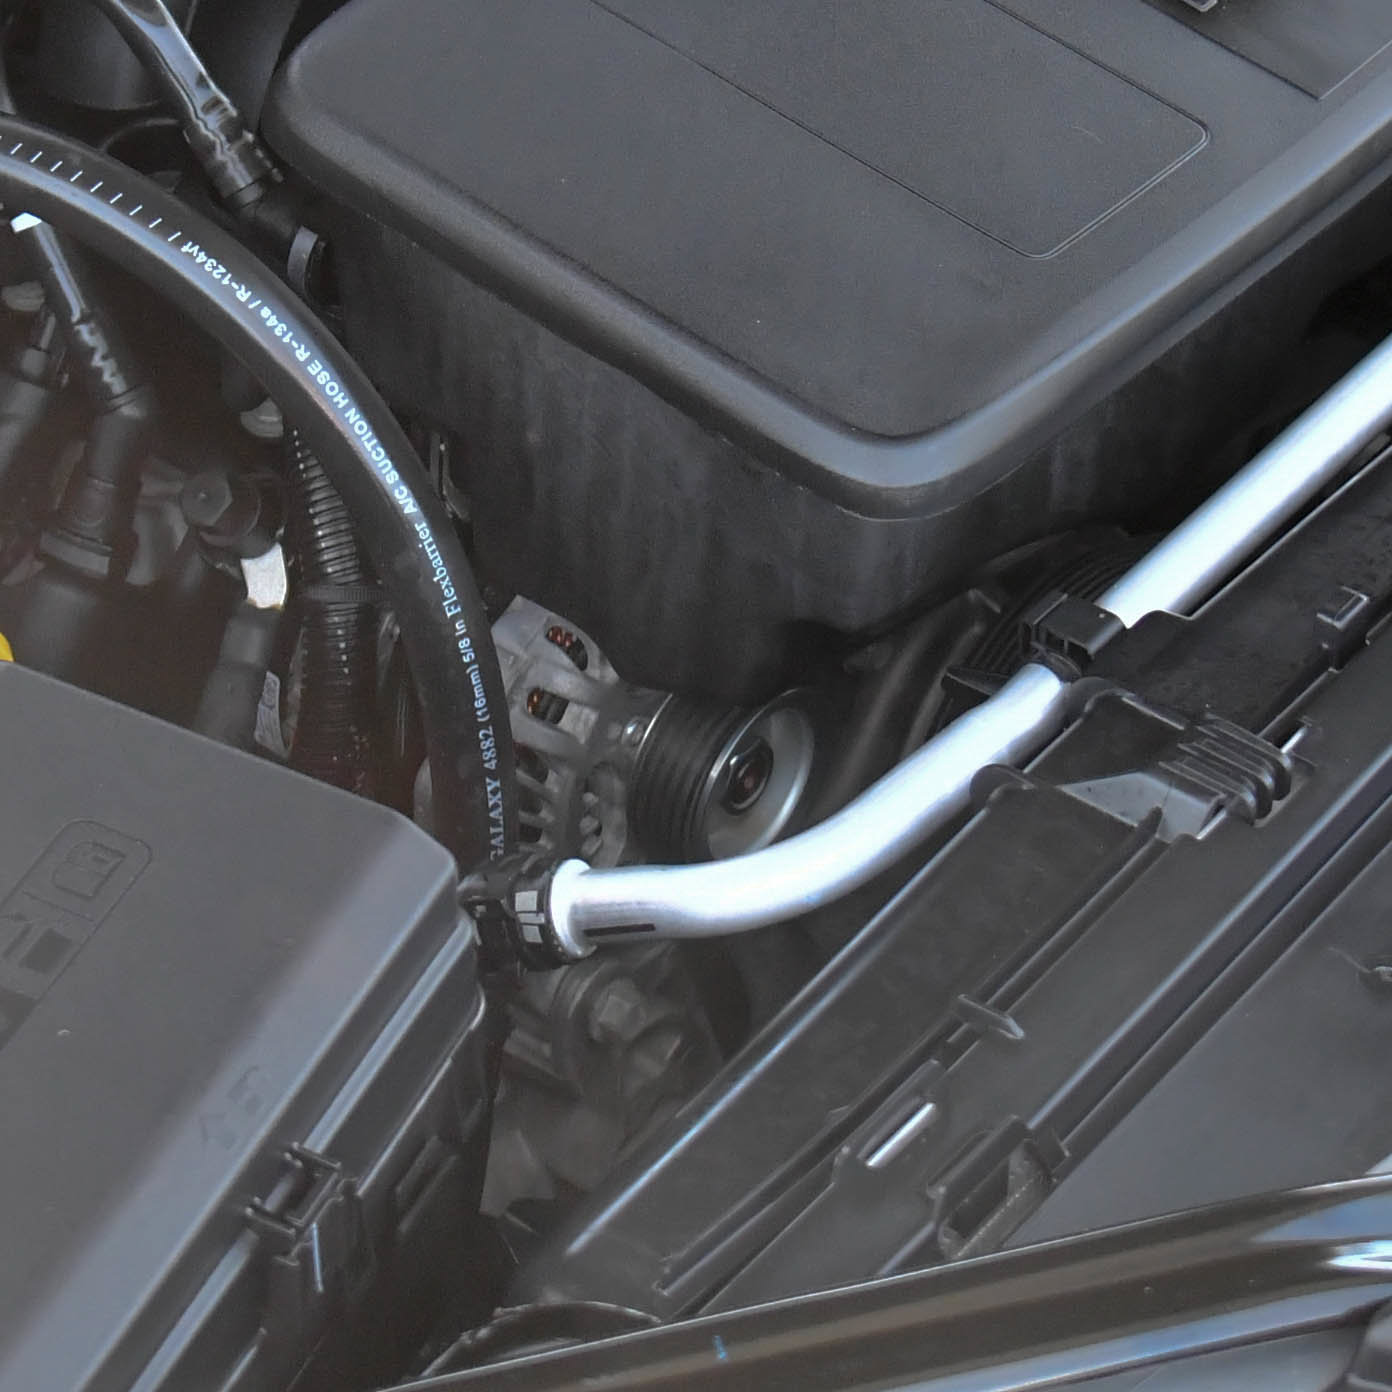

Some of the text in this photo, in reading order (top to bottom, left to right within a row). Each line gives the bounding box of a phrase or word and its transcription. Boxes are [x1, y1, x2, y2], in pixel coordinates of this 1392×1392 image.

[181, 241, 252, 302] R-1234yf
[260, 306, 311, 361] R-134a
[307, 359, 349, 409] HOSE
[344, 407, 400, 485] SUCTION
[394, 485, 418, 514] A/C
[414, 522, 462, 618] Flexbarrier
[458, 637, 475, 662] 5/8
[465, 664, 490, 722] (16mm)
[479, 725, 497, 770] 4882
